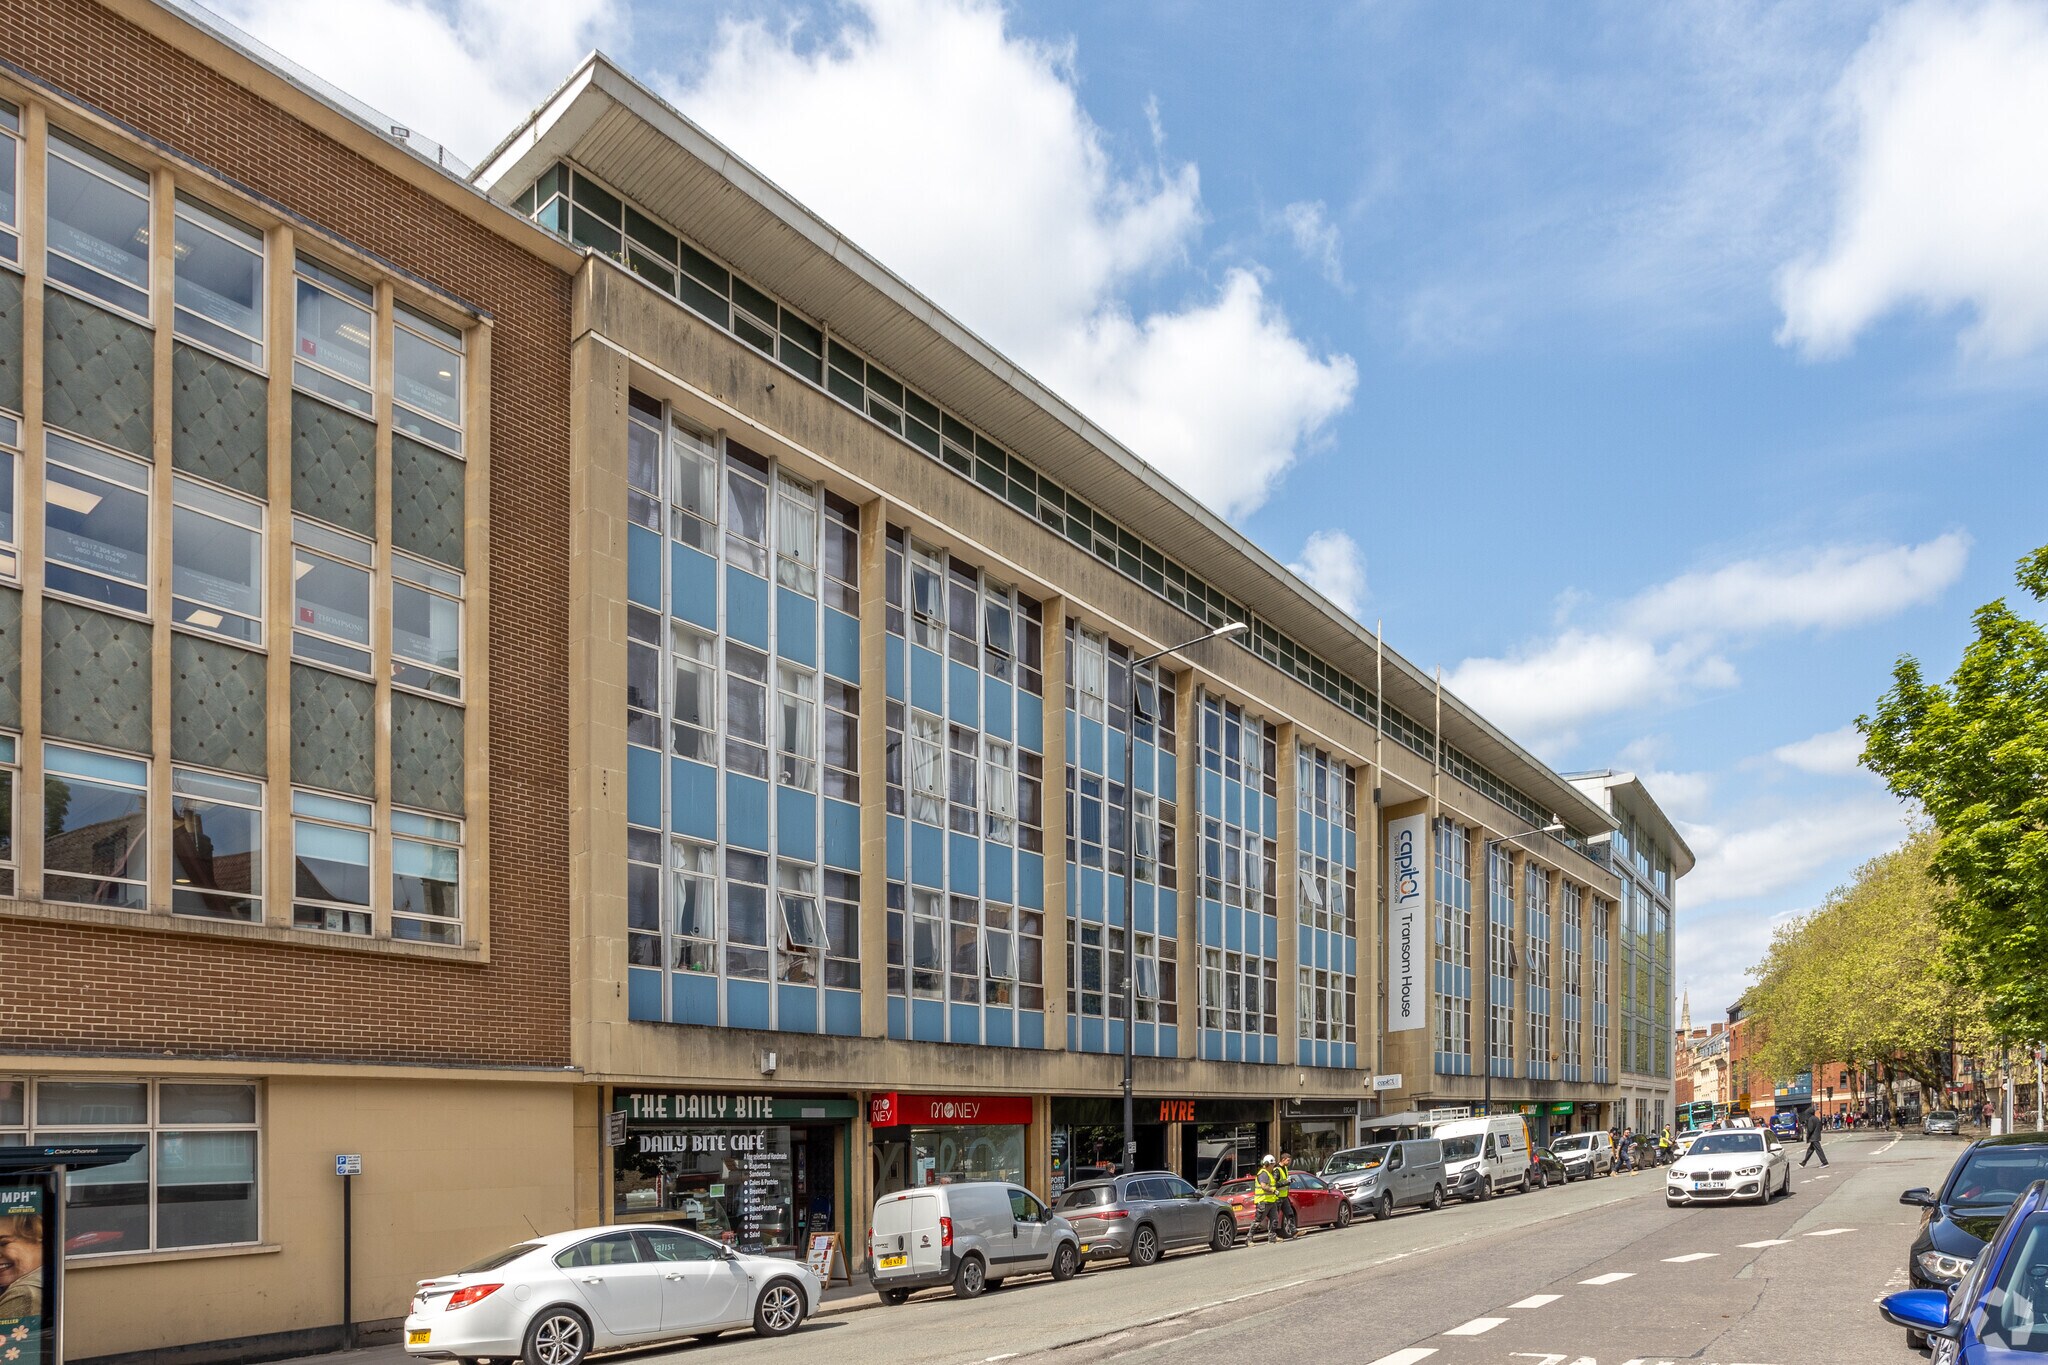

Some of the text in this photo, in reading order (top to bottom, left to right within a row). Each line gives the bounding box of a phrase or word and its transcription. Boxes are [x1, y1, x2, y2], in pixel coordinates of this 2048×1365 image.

[75, 545, 91, 555] 0800
[92, 550, 104, 559] 783
[82, 540, 98, 551] 0117
[111, 550, 128, 560] 2400
[318, 613, 364, 633] THOMPSONS
[1401, 912, 1413, 1017] Transom House
[630, 1094, 773, 1119] THE DAILY BITE
[872, 1110, 893, 1122] NEY
[930, 1101, 981, 1119] MONEY
[1159, 1100, 1196, 1121] HYRE
[639, 1129, 765, 1153] DAILY BITE CAFÉ
[764, 1178, 779, 1186] Pastries
[761, 1204, 777, 1212] Potatoes
[749, 1222, 760, 1230] Soup
